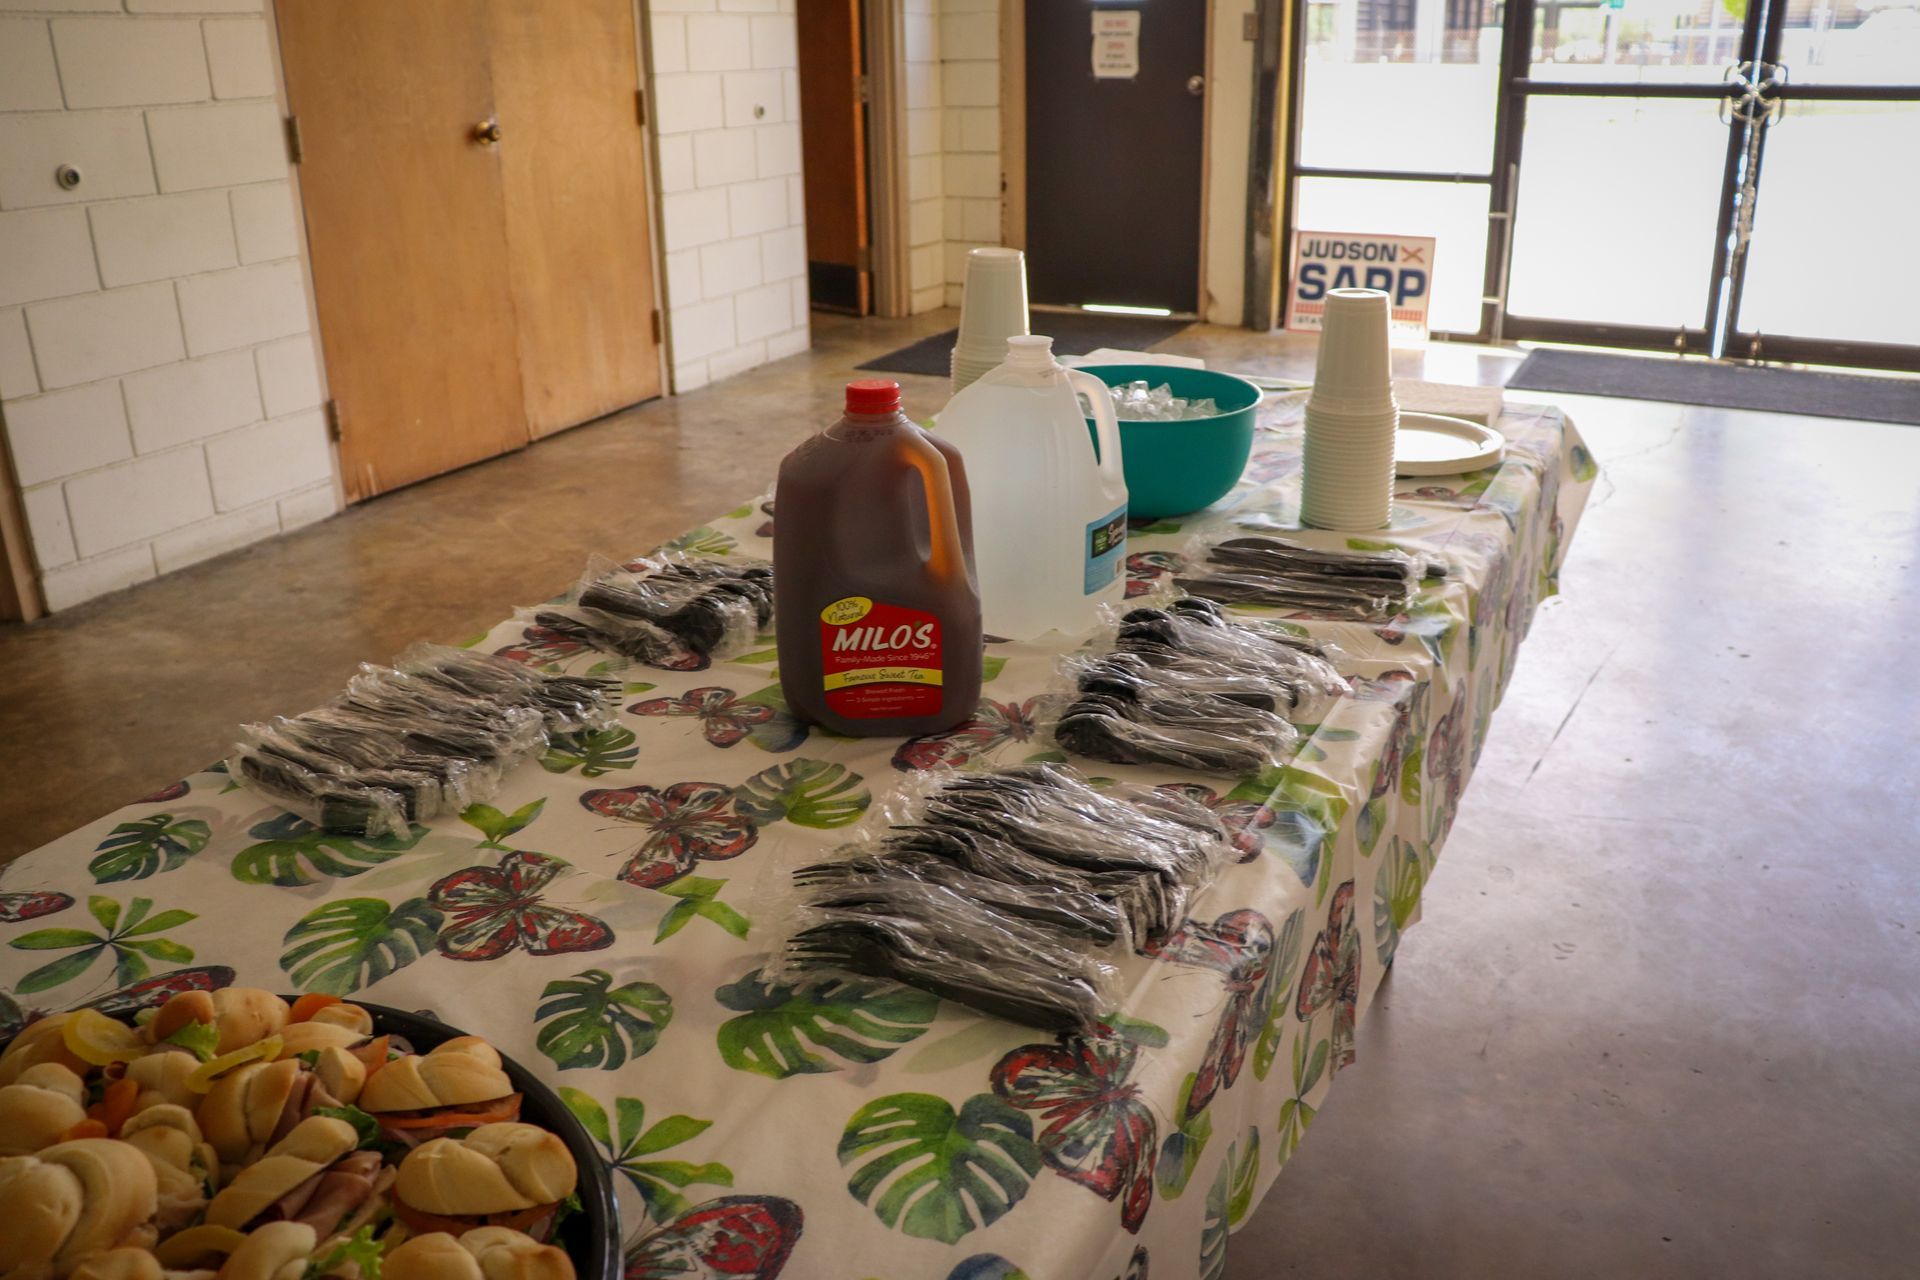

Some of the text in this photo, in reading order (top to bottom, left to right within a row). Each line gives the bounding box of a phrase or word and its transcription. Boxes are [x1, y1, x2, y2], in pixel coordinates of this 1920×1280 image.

[1302, 239, 1397, 263] JUDSON
[1297, 262, 1427, 306] SAPP
[836, 600, 858, 611] 100%
[829, 606, 863, 622] Natural
[887, 654, 909, 662] Since
[843, 668, 925, 682] Famous Sweet Tea
